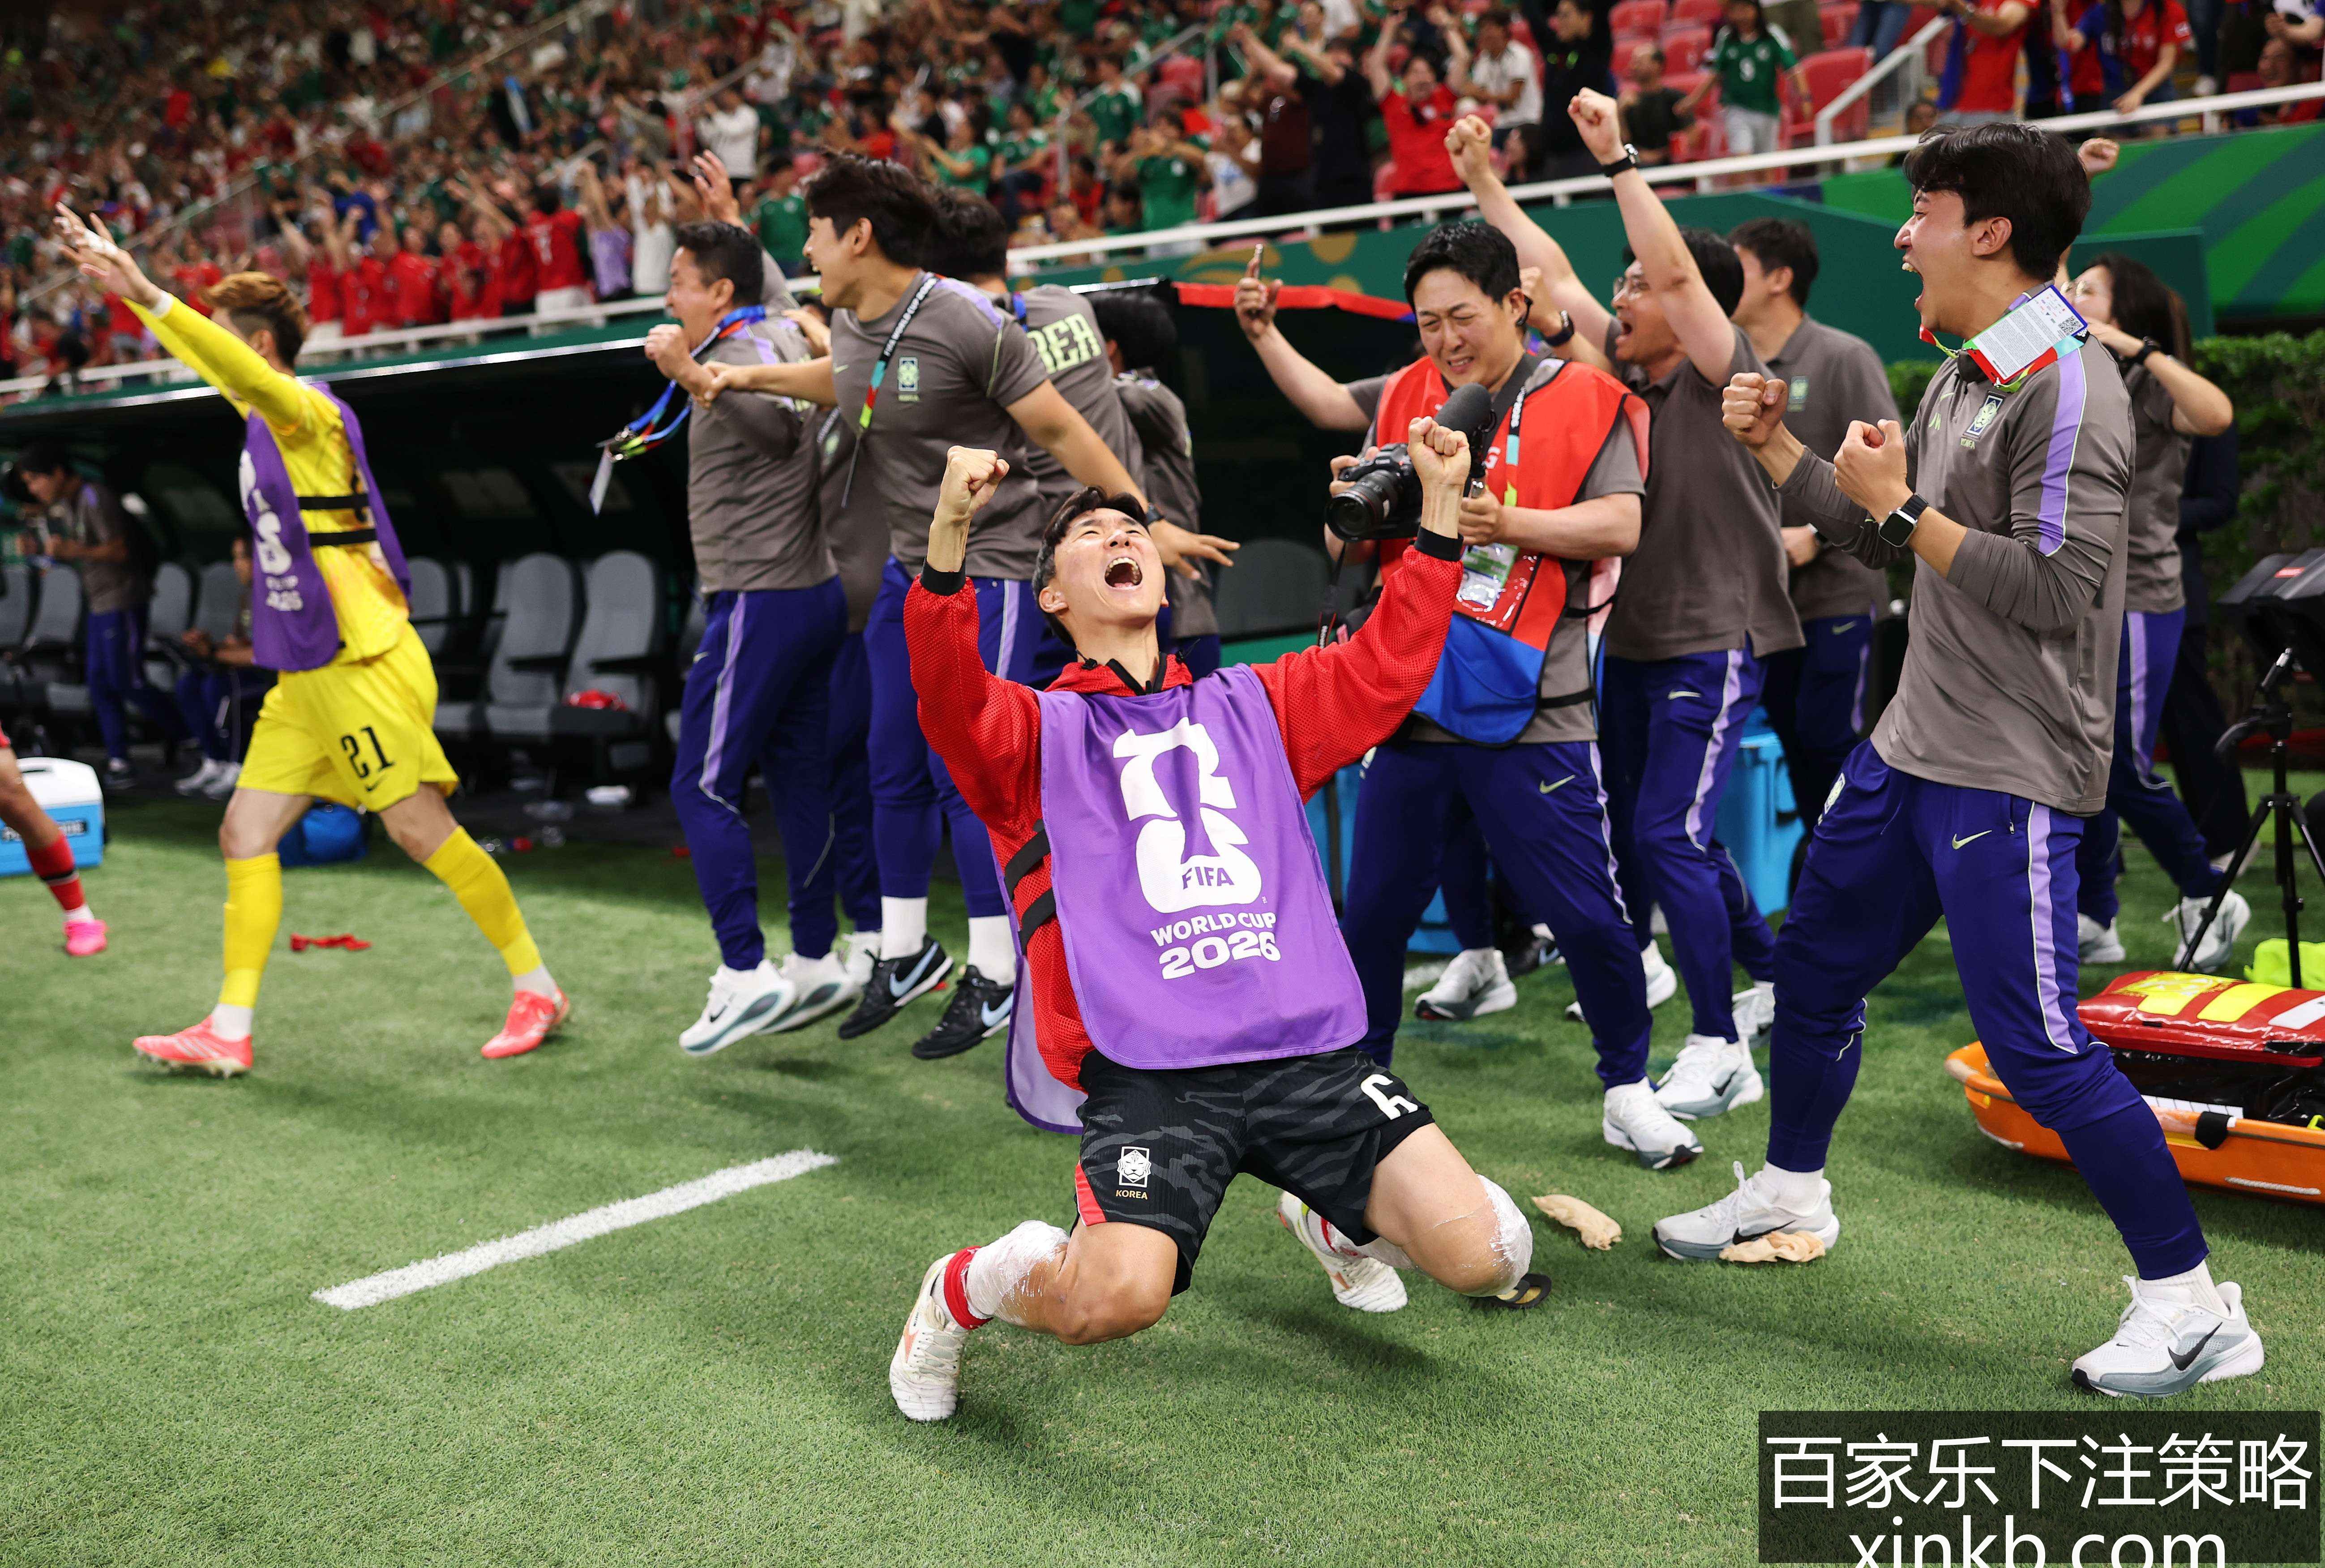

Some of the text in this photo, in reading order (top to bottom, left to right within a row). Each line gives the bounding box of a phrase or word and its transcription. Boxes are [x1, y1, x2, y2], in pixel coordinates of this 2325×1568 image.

[341, 725, 395, 778] 21
[1182, 866, 1234, 890] FIFA
[1150, 912, 1277, 947] WORLD CUP
[1159, 930, 1281, 980] 2026
[1115, 1189, 1148, 1200] KOREA
